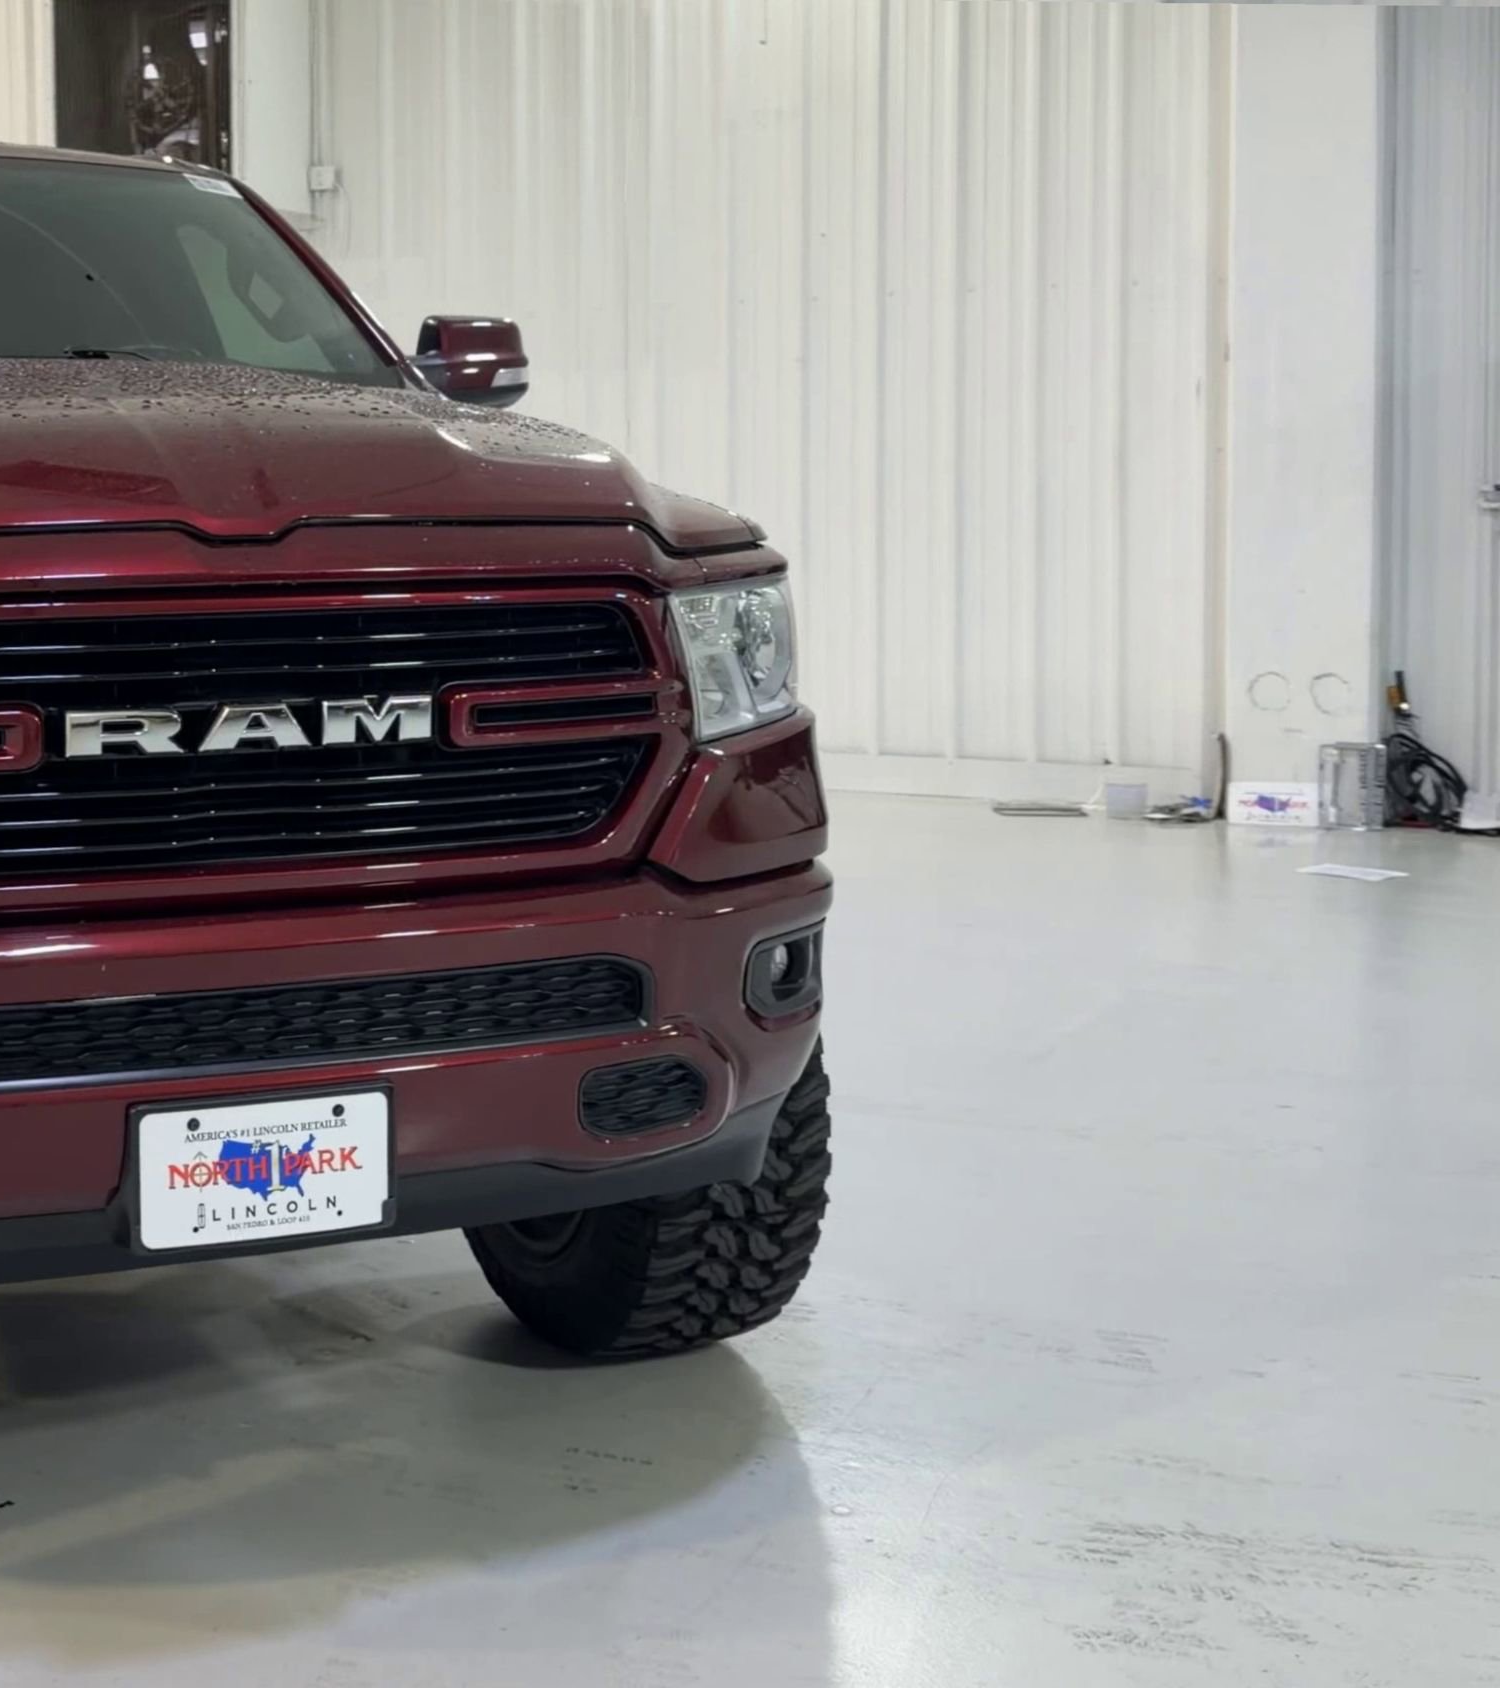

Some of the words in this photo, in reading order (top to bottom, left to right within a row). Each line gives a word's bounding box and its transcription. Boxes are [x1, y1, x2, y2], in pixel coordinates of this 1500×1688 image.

[65, 695, 432, 758] RAM
[184, 1128, 238, 1144] AMERICA'S
[240, 1128, 250, 1138] #1
[253, 1123, 298, 1136] LINCOLN
[300, 1118, 347, 1132] RETAILER
[168, 1155, 268, 1189] NORTH
[283, 1146, 362, 1176] PARK
[212, 1195, 337, 1222] LINCOLN
